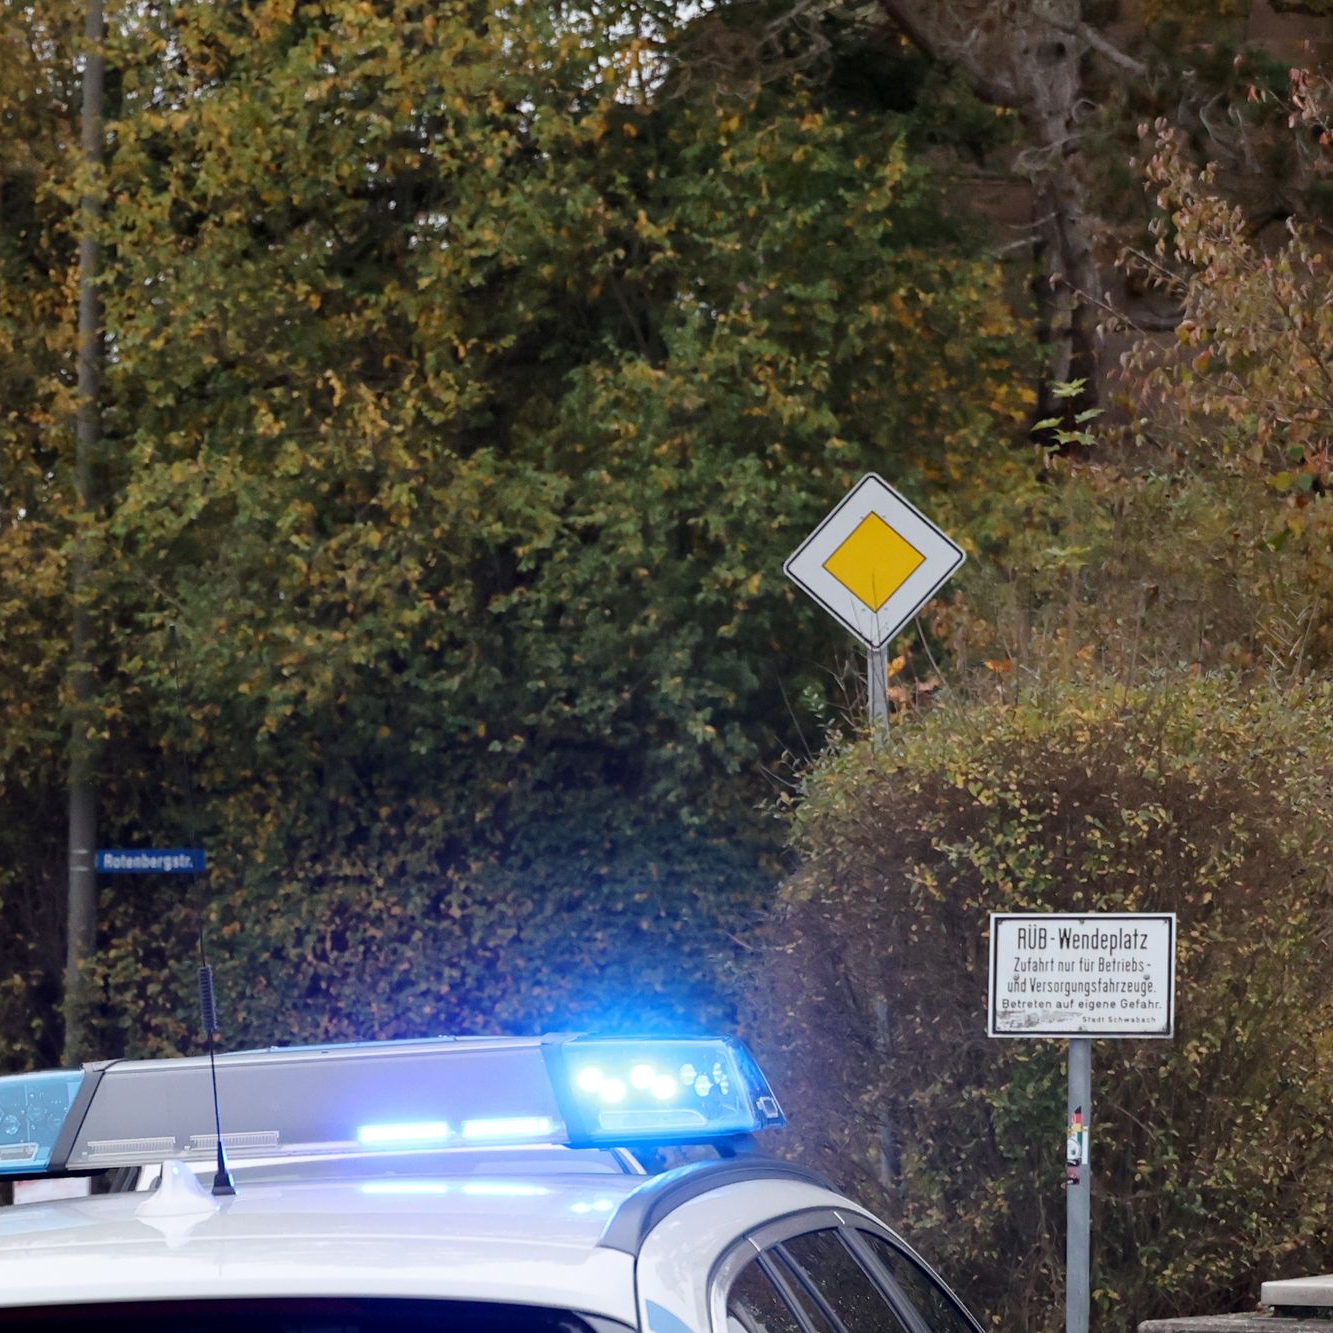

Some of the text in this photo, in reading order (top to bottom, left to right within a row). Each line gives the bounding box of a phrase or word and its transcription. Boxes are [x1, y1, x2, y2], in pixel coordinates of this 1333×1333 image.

[1014, 957, 1054, 973] Zufahrt
[1058, 960, 1075, 973] nur
[1079, 957, 1094, 973] für
[1007, 977, 1156, 997] und Versorgungsfahrzeuge.
[1002, 999, 1163, 1011] Betreten auf eigene Gefahr.
